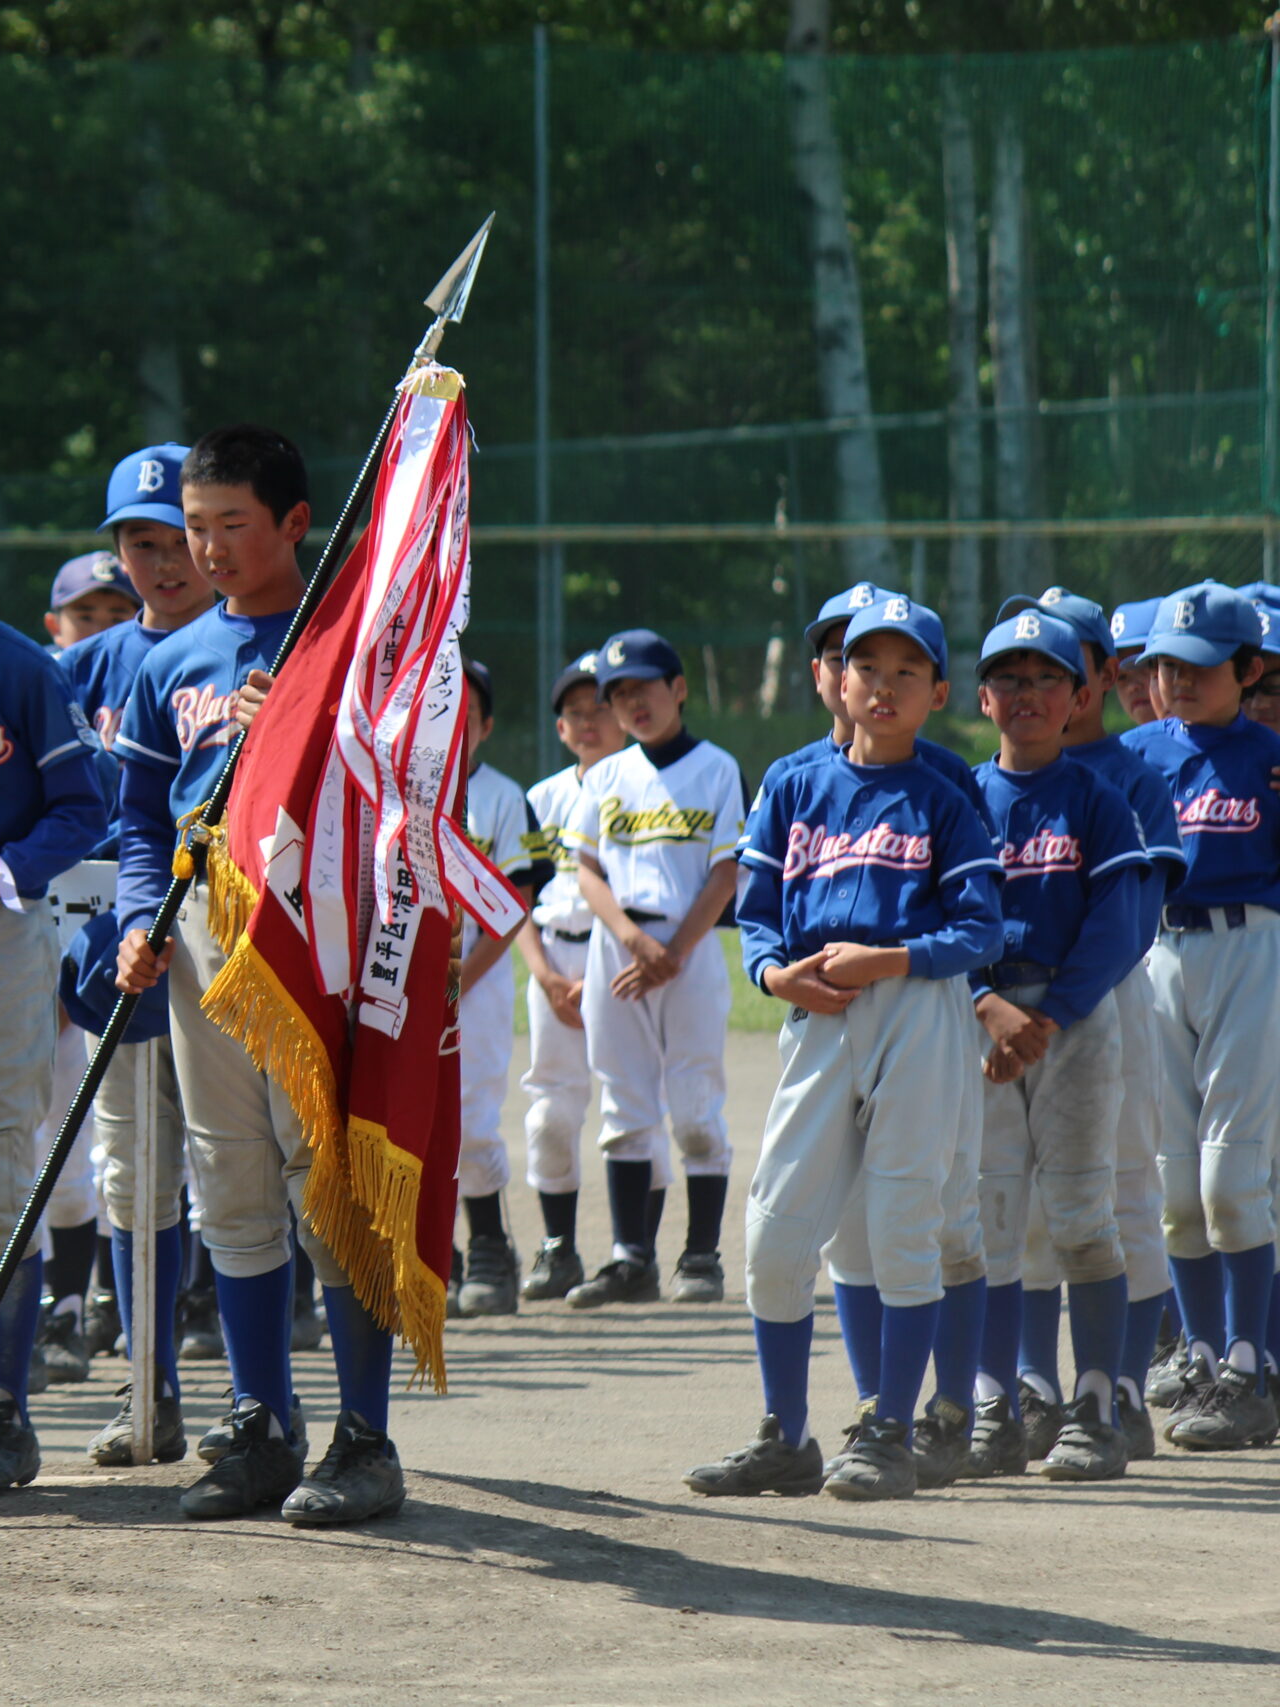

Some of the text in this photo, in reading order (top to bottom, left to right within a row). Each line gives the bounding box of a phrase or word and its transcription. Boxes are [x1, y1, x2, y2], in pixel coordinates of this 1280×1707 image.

[137, 459, 164, 493] B
[848, 585, 874, 609] B
[882, 598, 910, 622] B
[1173, 601, 1195, 629] B
[1015, 615, 1041, 640] B
